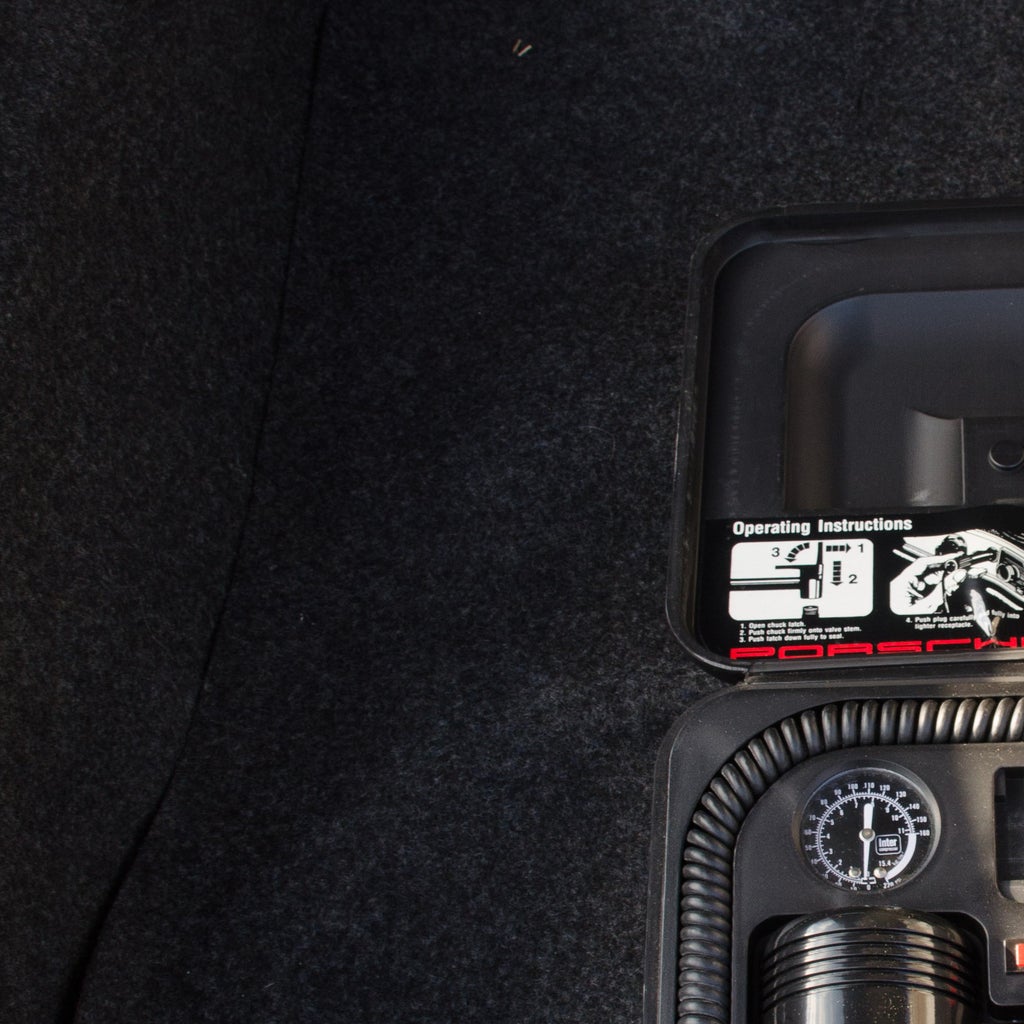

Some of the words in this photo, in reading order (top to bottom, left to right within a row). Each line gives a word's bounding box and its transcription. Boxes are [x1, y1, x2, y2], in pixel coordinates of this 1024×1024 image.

[733, 520, 810, 537] Operating
[818, 518, 912, 534] Instructions
[771, 547, 780, 557] 3
[858, 544, 864, 552] 1
[848, 574, 857, 584] 2
